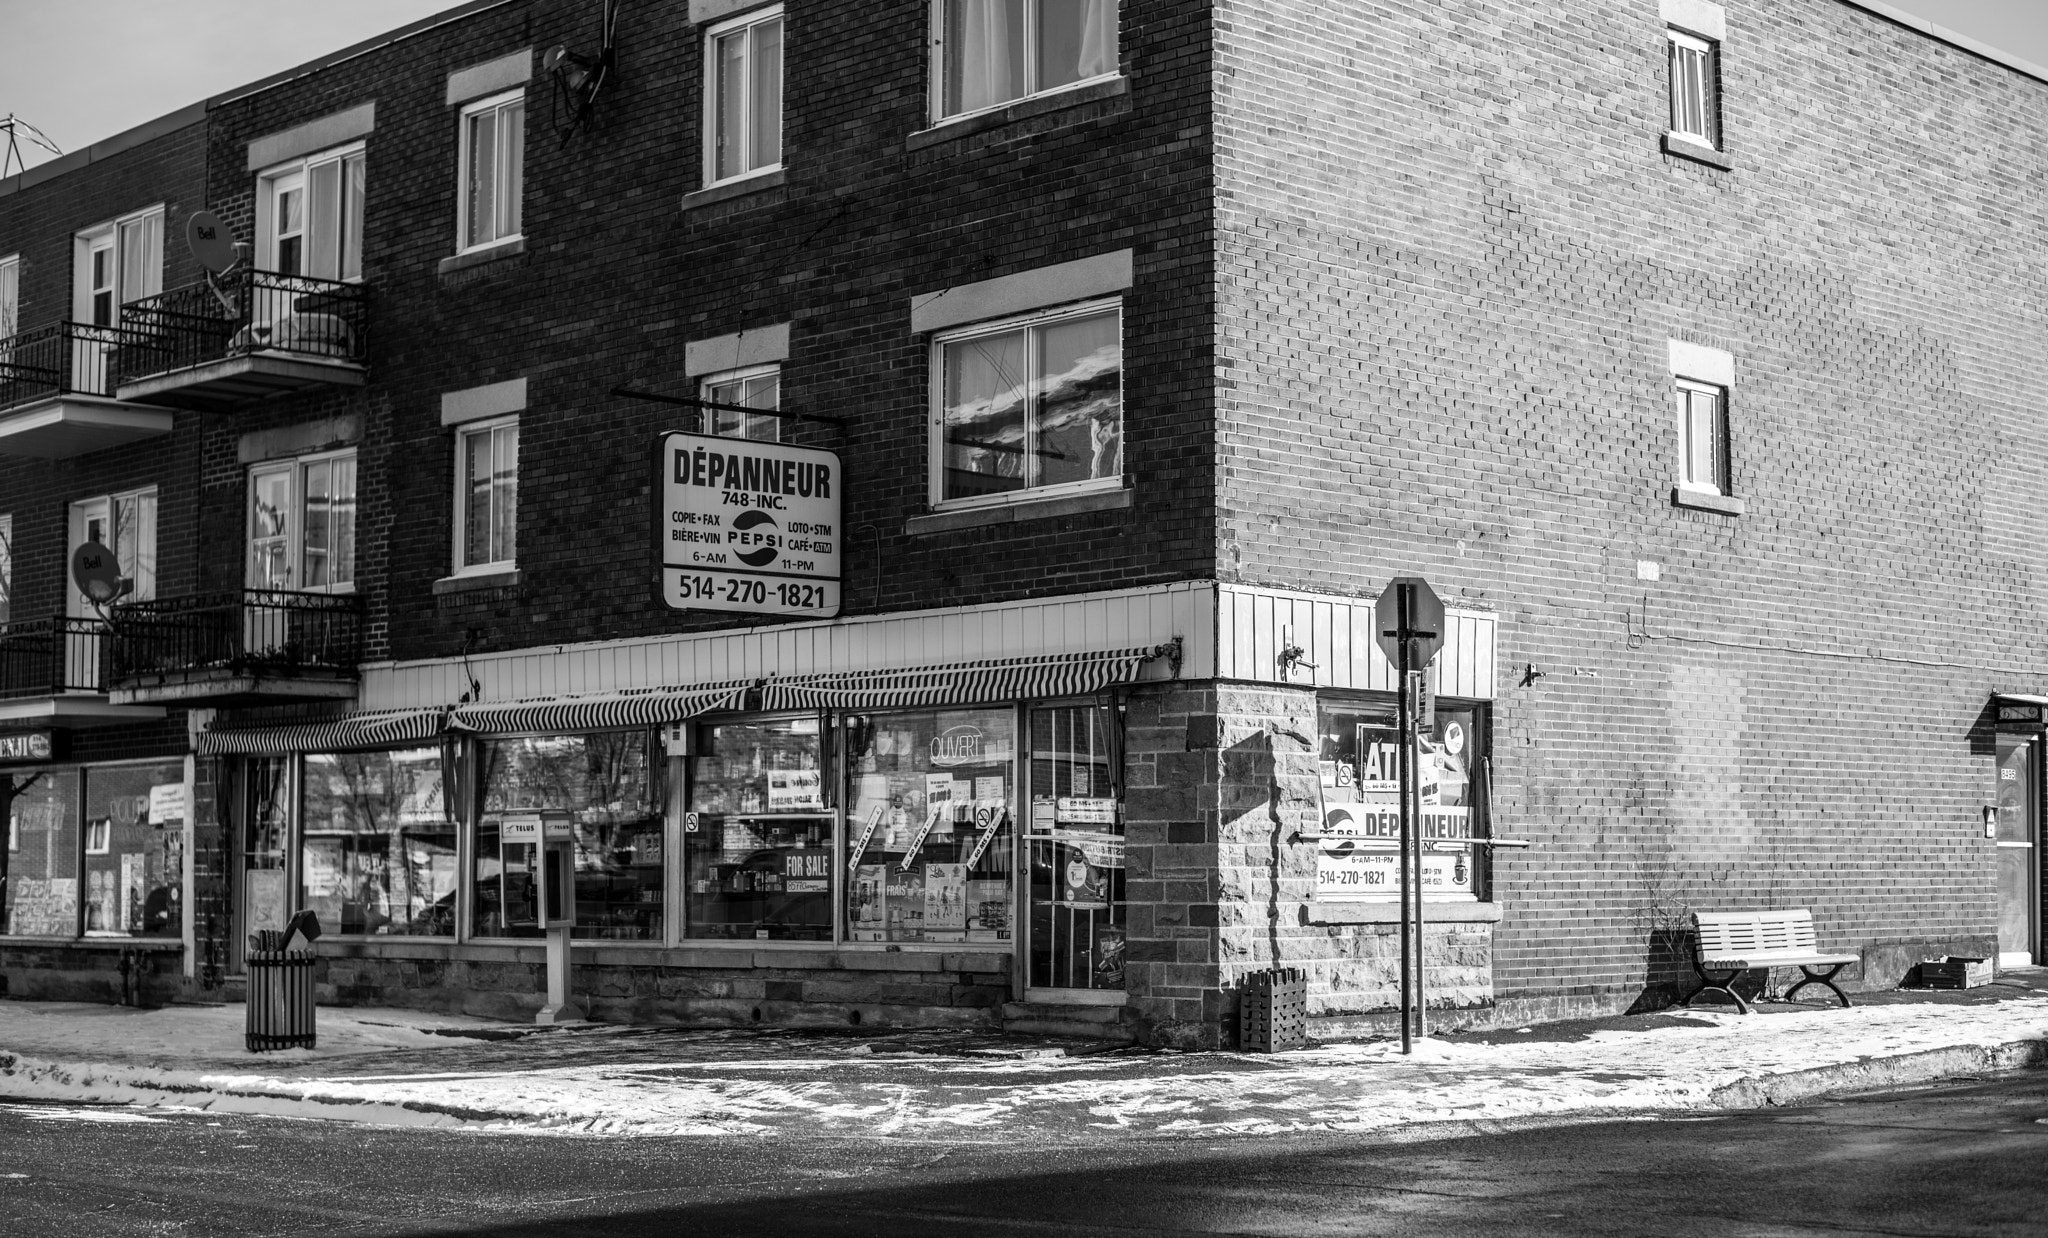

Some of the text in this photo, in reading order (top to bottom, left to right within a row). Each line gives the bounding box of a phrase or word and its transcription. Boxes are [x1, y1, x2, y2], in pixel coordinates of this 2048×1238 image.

[197, 226, 216, 240] Bell
[674, 446, 831, 499] DÉPANNEUR
[721, 491, 787, 510] 748-INC.
[728, 531, 783, 547] PEPSI
[83, 555, 102, 570] Bell
[693, 551, 727, 563] 6-AM
[782, 559, 814, 571] 11-PM
[680, 575, 824, 608] 514-270-1821
[930, 735, 981, 760] OUVERT
[516, 824, 535, 832] TELUS
[786, 855, 828, 876] FOR SALE
[1320, 871, 1385, 885] 514-270-1821
